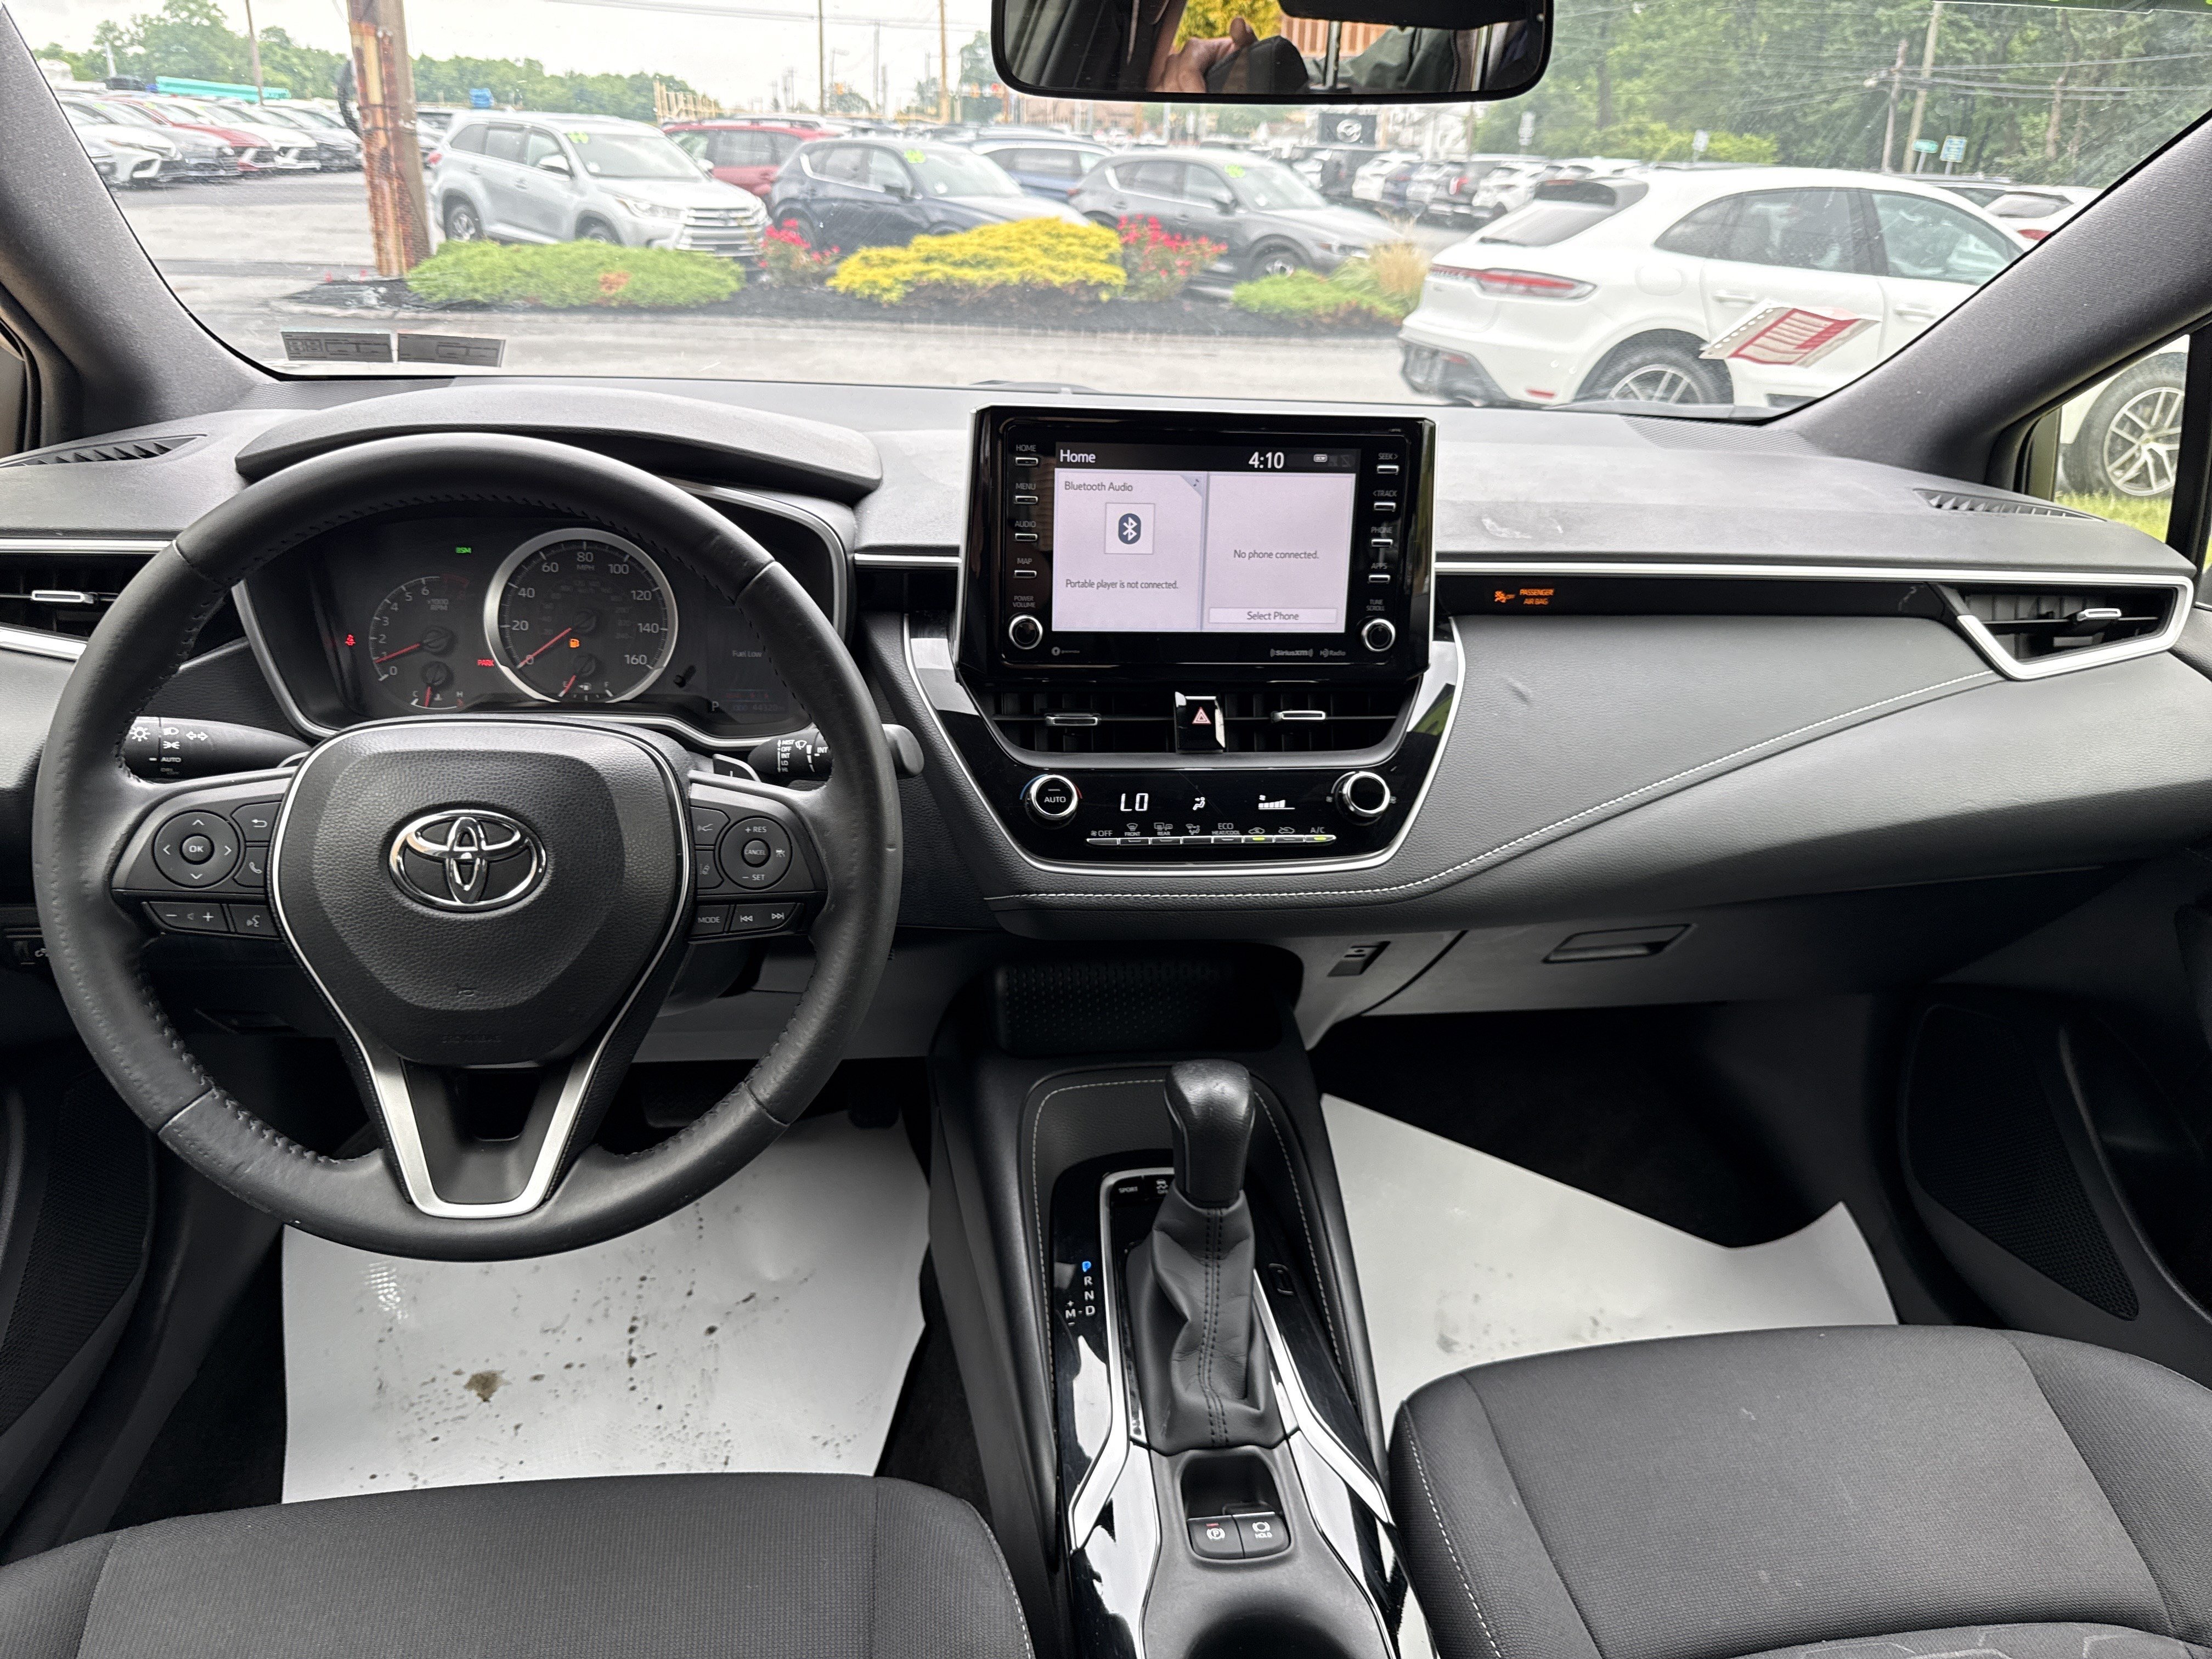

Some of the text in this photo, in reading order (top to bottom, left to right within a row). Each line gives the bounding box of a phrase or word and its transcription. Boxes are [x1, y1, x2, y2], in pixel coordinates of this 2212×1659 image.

[1060, 449, 1096, 463] Home
[1249, 452, 1284, 469] 4:10
[1064, 481, 1133, 492] Bluetooth Audio
[577, 552, 594, 562] 80
[1234, 550, 1319, 560] No phone connected.
[541, 562, 559, 573] 60
[608, 564, 630, 574] 100
[1065, 579, 1095, 588] Portable
[1096, 579, 1118, 590] player
[1140, 580, 1179, 589] connected.
[421, 587, 430, 595] 6
[518, 588, 535, 598] 40
[631, 590, 652, 601] 120
[405, 592, 413, 601] 5
[391, 603, 399, 612] 4
[1247, 611, 1299, 620] Select Phone
[382, 617, 390, 626] 3
[512, 620, 529, 631] 20
[637, 623, 659, 633] 140
[379, 634, 387, 644] 2
[525, 654, 534, 664] 0
[624, 654, 647, 665] 160
[388, 666, 398, 676] 0
[712, 701, 719, 711] P
[1120, 793, 1149, 811] LO
[697, 916, 721, 924] MODE
[1082, 1261, 1092, 1273] P
[1084, 1276, 1093, 1286] R
[1084, 1290, 1095, 1301] N
[1065, 1305, 1096, 1319] M D
